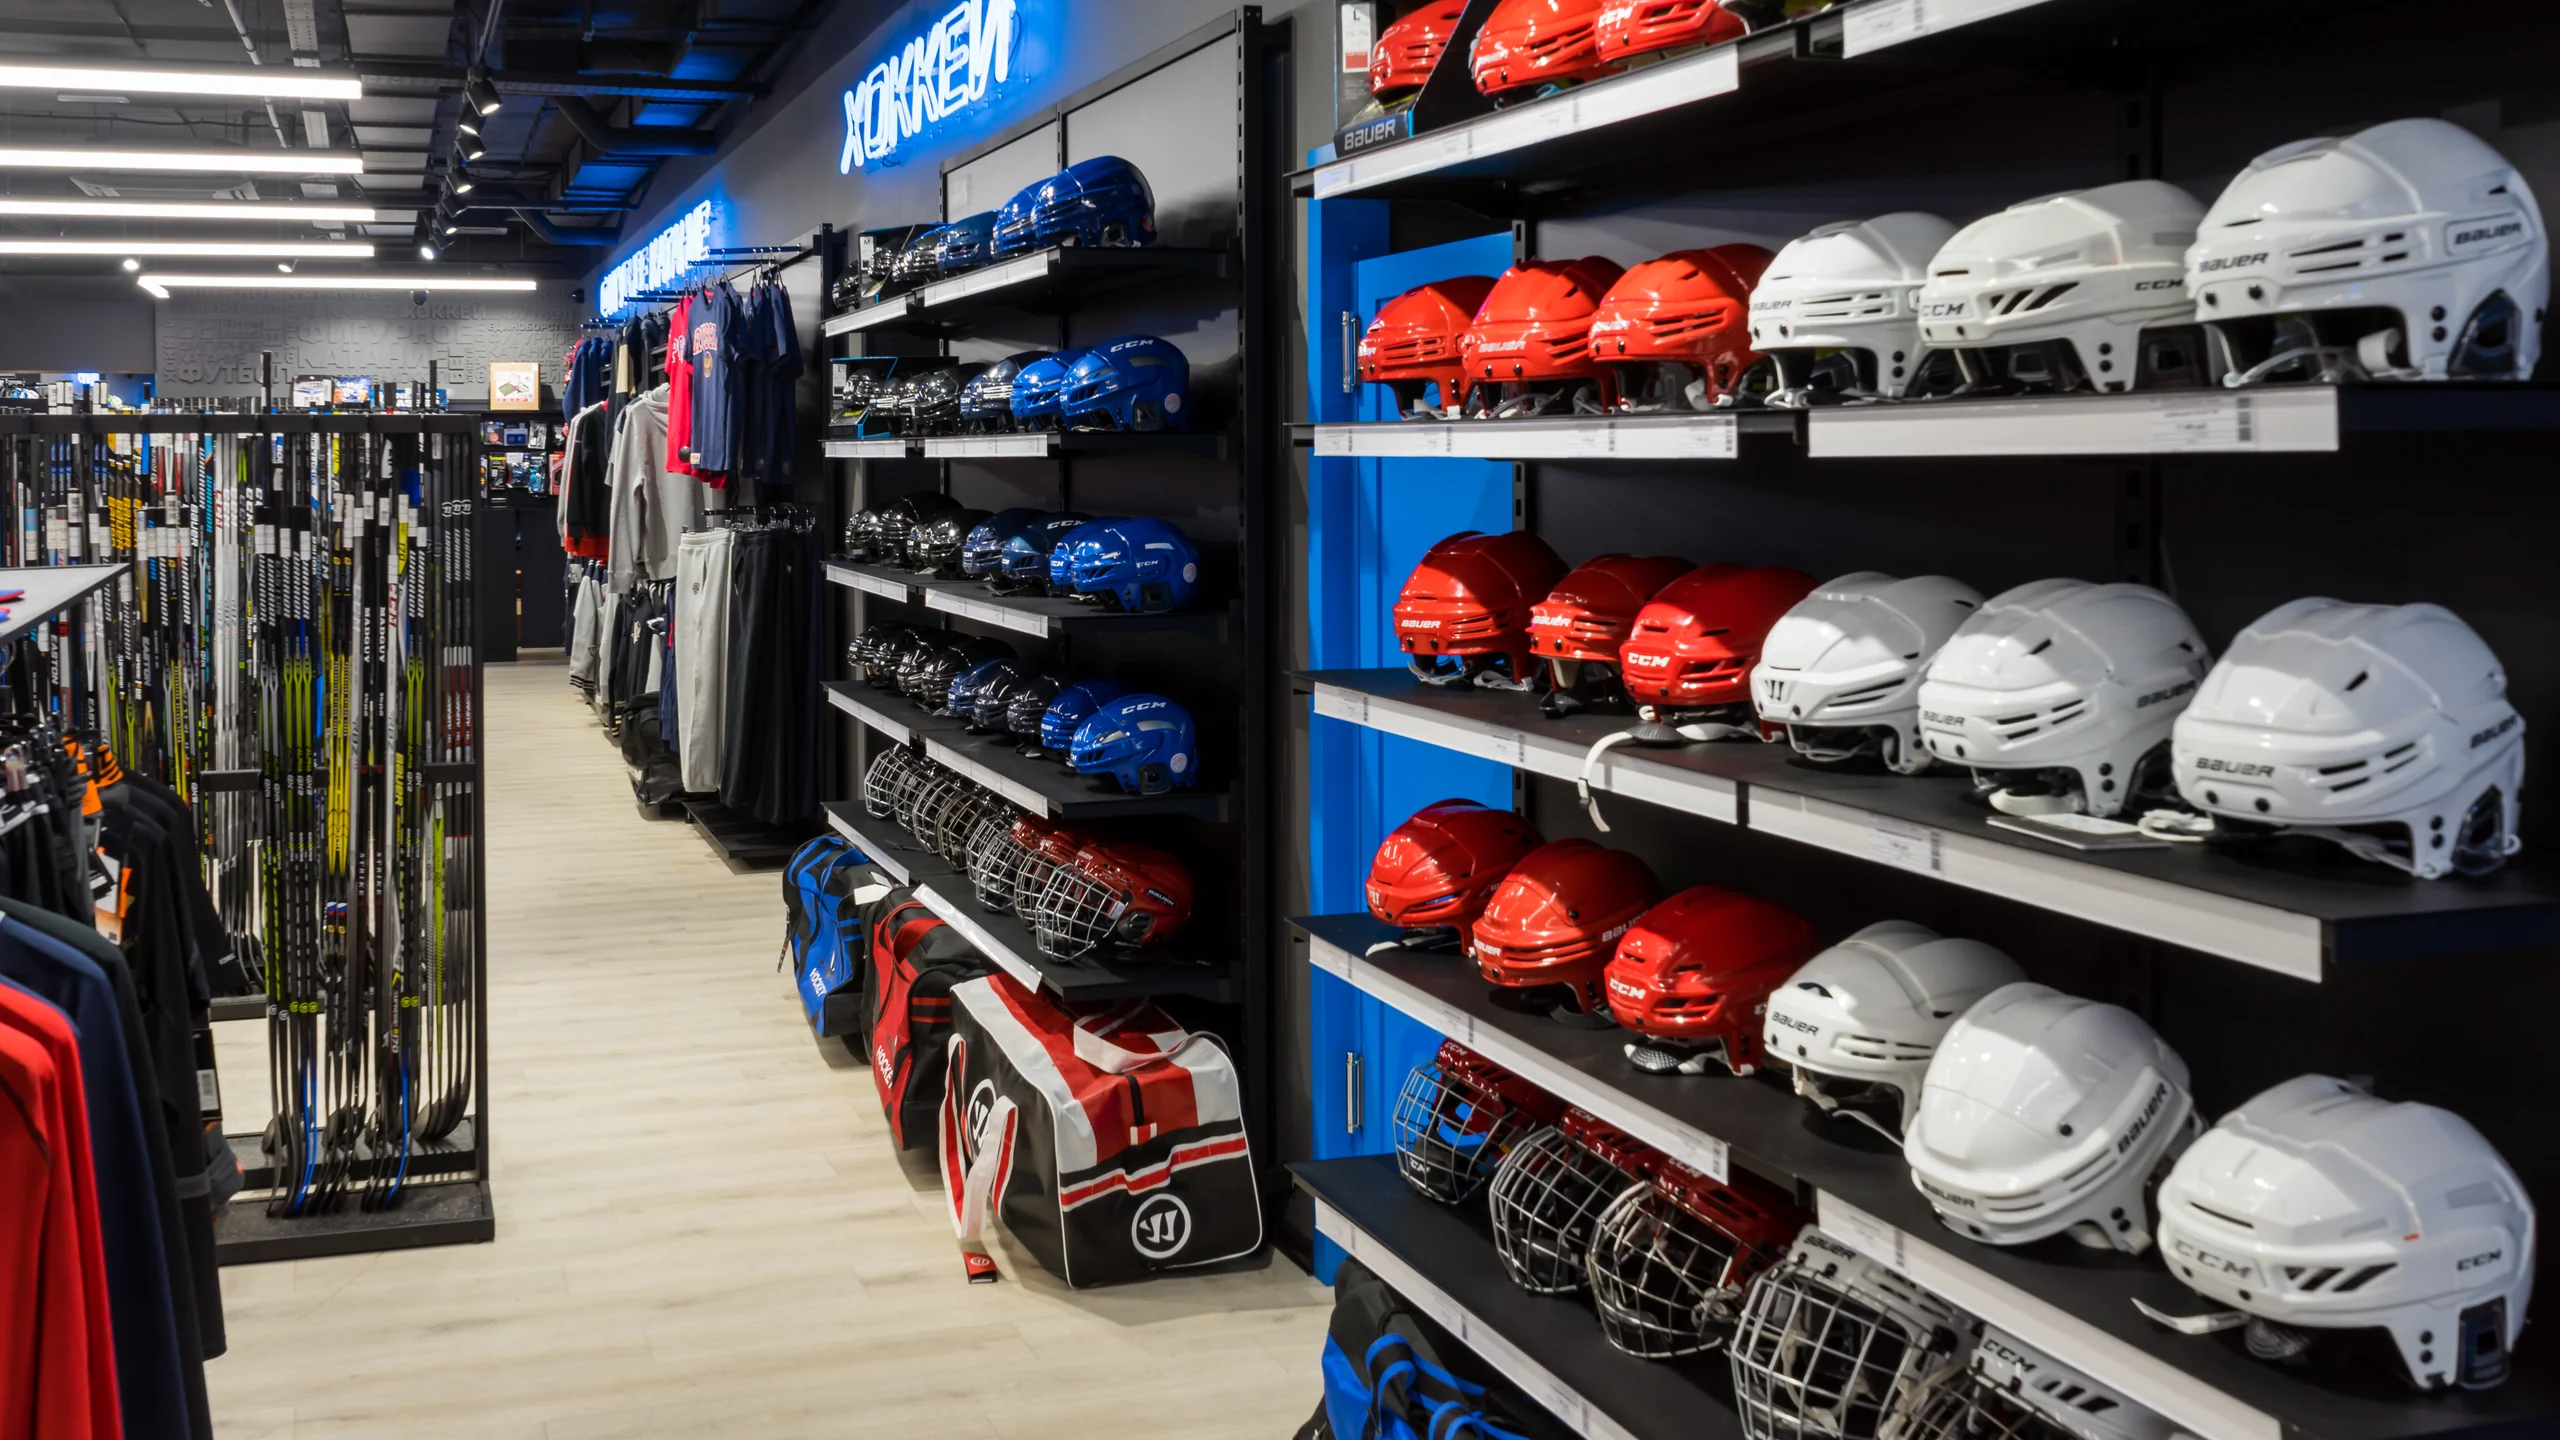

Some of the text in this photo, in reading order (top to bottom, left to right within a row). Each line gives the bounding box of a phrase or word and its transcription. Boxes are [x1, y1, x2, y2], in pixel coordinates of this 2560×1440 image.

[1353, 10, 1361, 21] L
[1597, 6, 1633, 28] CCM
[1344, 117, 1397, 151] BAUER
[2455, 221, 2523, 245] BAUER
[2199, 252, 2269, 274] BAUER
[2134, 279, 2185, 291] CCM
[1922, 302, 1966, 318] CCM
[1110, 339, 1155, 353] CCM
[1478, 340, 1527, 353] BAUER
[1135, 560, 1159, 570] CCM
[1401, 619, 1442, 630] BAUER
[1532, 613, 1572, 628] BAUER
[1627, 652, 1671, 668] CCM
[2136, 679, 2197, 709] BAUER
[1121, 702, 1167, 715] CCM
[1922, 710, 1966, 727] BAUER
[2470, 714, 2518, 749] BAUER
[2195, 756, 2275, 779] BAUER
[1147, 889, 1175, 907] BAUER
[1473, 936, 1503, 958] BAUER
[808, 967, 827, 998] HOCKEY
[1608, 976, 1647, 1000] CCM
[1772, 1011, 1822, 1037] BAUER
[1443, 1041, 1469, 1058] CCM
[1569, 1106, 1597, 1124] CCM
[2116, 1082, 2169, 1154] BAUER
[1920, 1180, 1976, 1208] BAUER
[1803, 1234, 1857, 1261] BAUER
[2175, 1240, 2251, 1279] CCM
[2456, 1249, 2503, 1272] CCM
[1983, 1338, 2038, 1373] CCM
